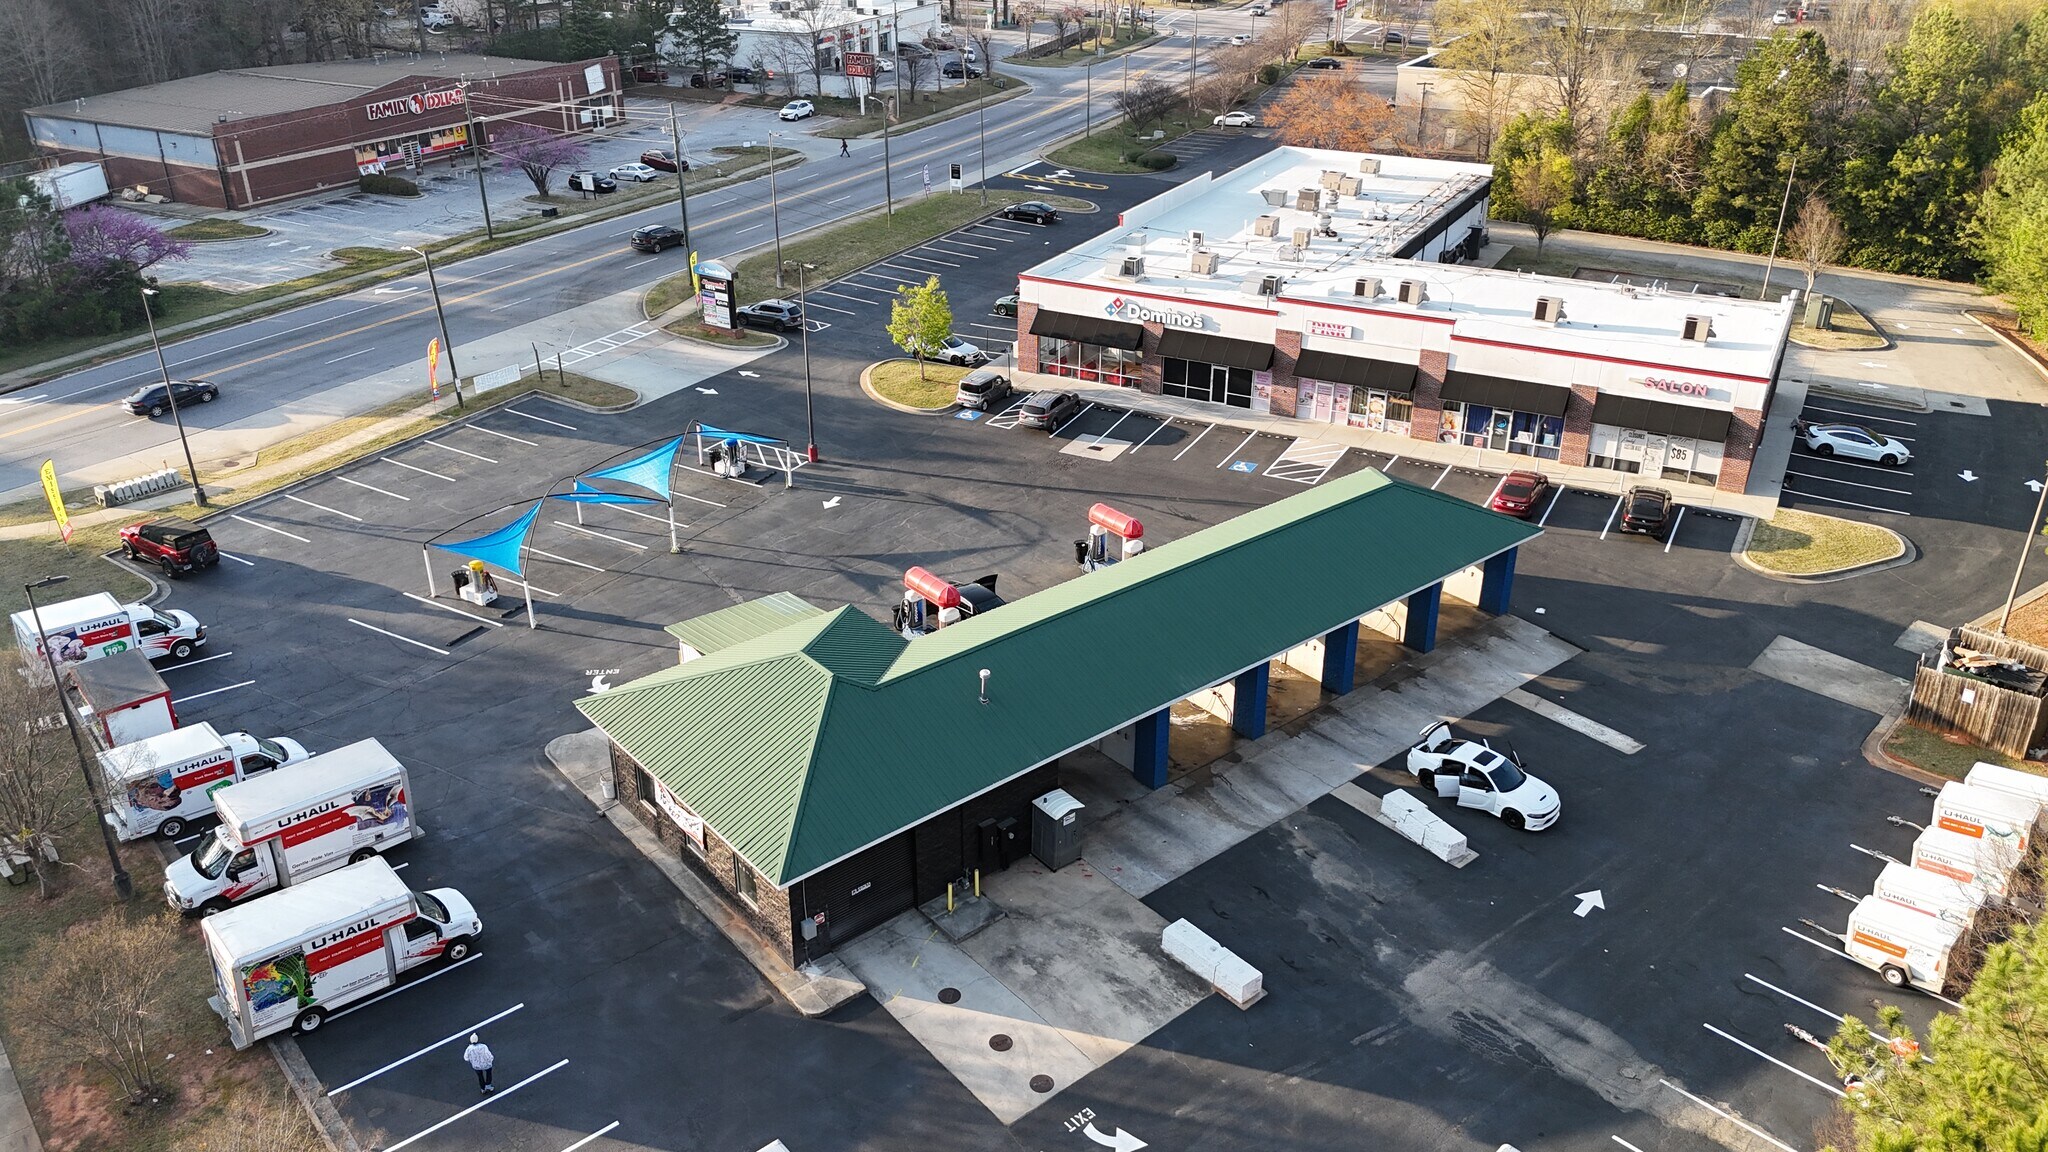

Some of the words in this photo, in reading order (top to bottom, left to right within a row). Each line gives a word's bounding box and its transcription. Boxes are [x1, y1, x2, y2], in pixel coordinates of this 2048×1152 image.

[847, 55, 872, 65] FAMILY
[367, 98, 409, 120] FAMILY
[425, 89, 465, 110] DOLLAR
[1126, 303, 1204, 329] Domino's
[1644, 377, 1708, 397] SALON
[1670, 447, 1687, 461] $85
[80, 618, 123, 632] U-HAUL
[177, 755, 226, 773] U-HAUL
[278, 801, 340, 828] U-HAUL
[1943, 809, 1983, 825] U-HAUL
[1920, 850, 1954, 866] U-HAUL
[1883, 891, 1918, 906] U-HAUL
[311, 918, 380, 950] U-HAUL
[1857, 925, 1892, 942] U-HAUL
[1063, 1107, 1097, 1133] EXIT
